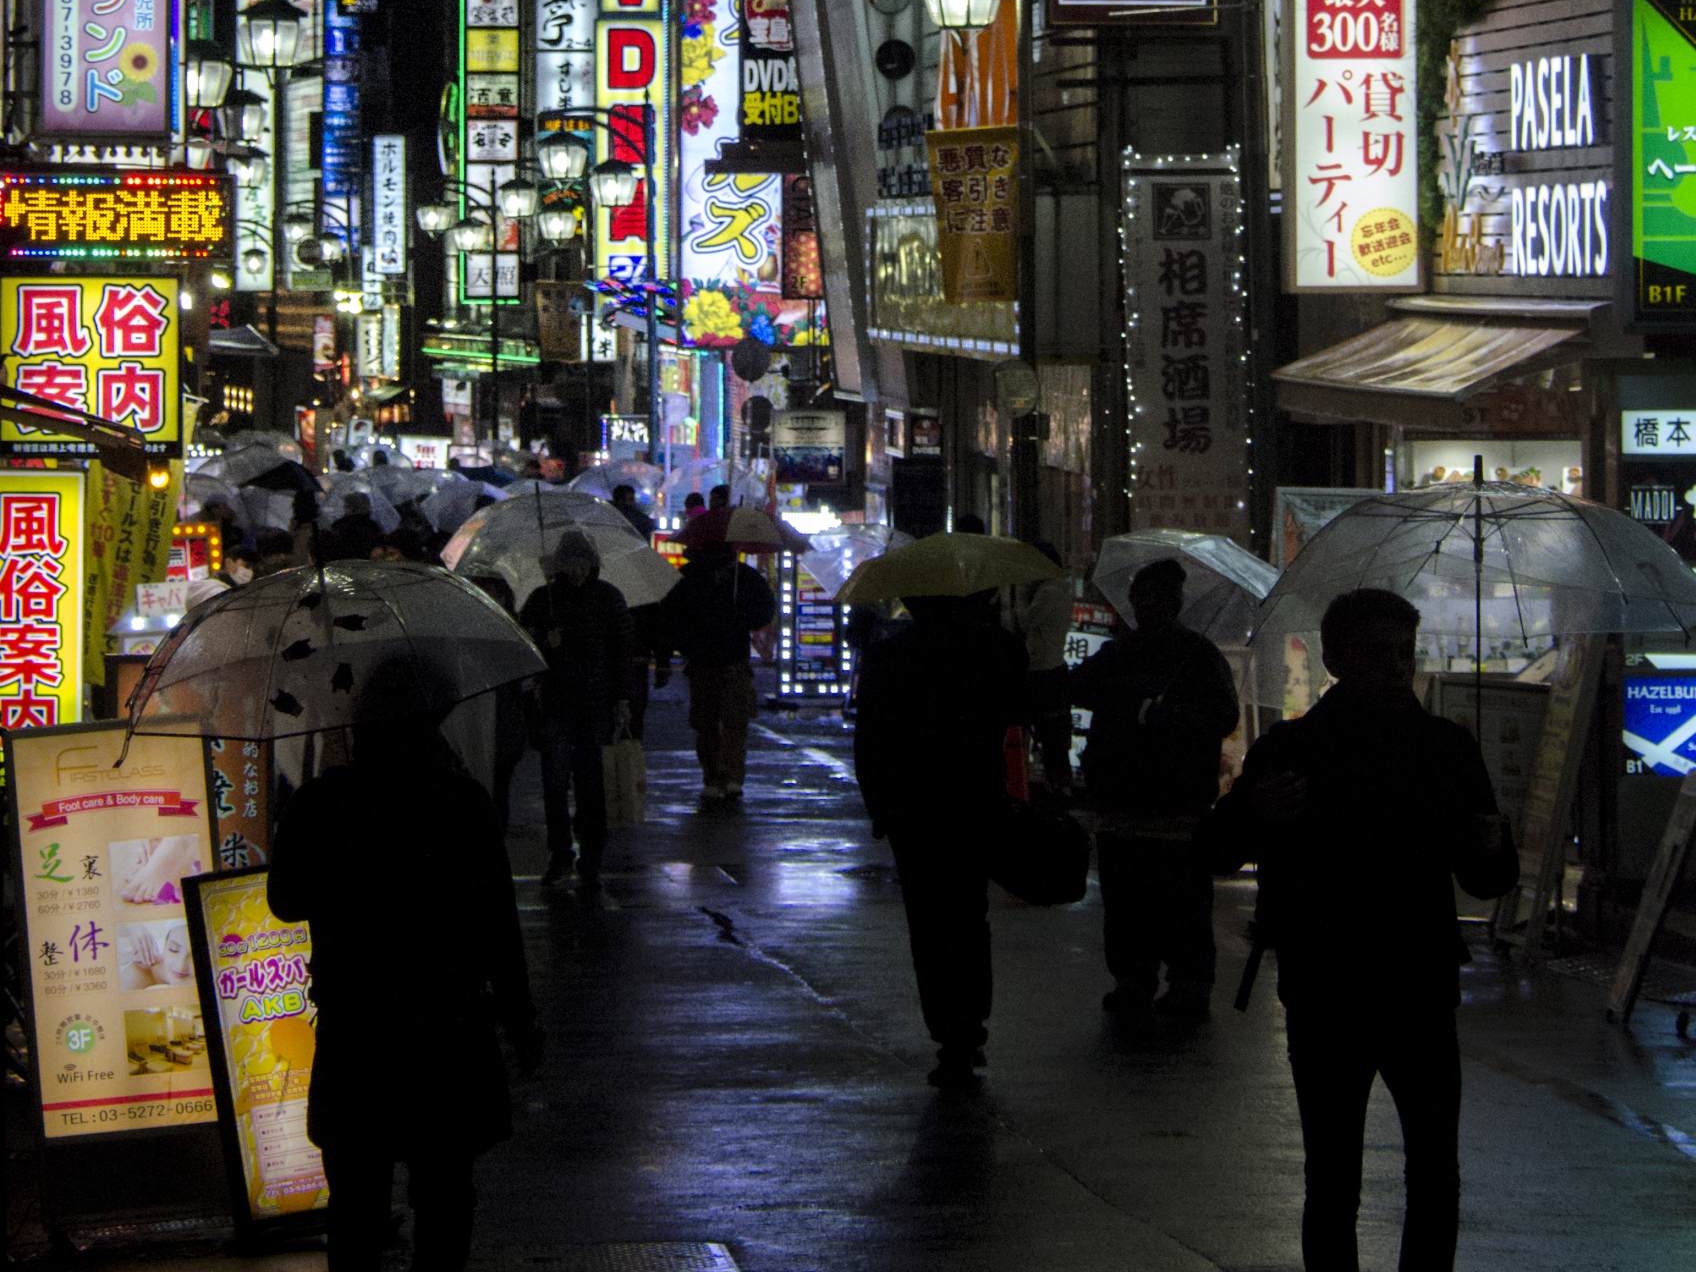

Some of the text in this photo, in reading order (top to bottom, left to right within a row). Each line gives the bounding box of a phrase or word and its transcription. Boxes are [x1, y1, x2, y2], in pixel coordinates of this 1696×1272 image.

[1510, 52, 1594, 151] PASELA
[1358, 71, 1405, 178] 貸切
[937, 144, 1011, 173] 悪質な
[1305, 68, 1355, 279] パーティー
[940, 175, 1010, 204] 客引き
[2, 190, 224, 242] 情報満載
[945, 206, 1012, 234] に注意
[1359, 216, 1400, 240] 忘年会
[1511, 180, 1610, 277] RESORTS
[1648, 284, 1686, 304] B1F
[11, 283, 168, 358] 風俗
[1157, 247, 1213, 456] 相席酒場
[1634, 417, 1692, 448] 橋本
[0, 493, 64, 728] 風俗案内
[1626, 759, 1643, 775] B1
[58, 801, 79, 814] Foot
[82, 797, 104, 810] care
[116, 793, 142, 808] Body
[143, 794, 165, 805] care
[34, 842, 103, 883] 足裏
[38, 920, 110, 967] 整体
[240, 987, 306, 1024] AKB
[67, 1029, 93, 1051] 3F
[56, 1069, 115, 1085] WiFi Free
